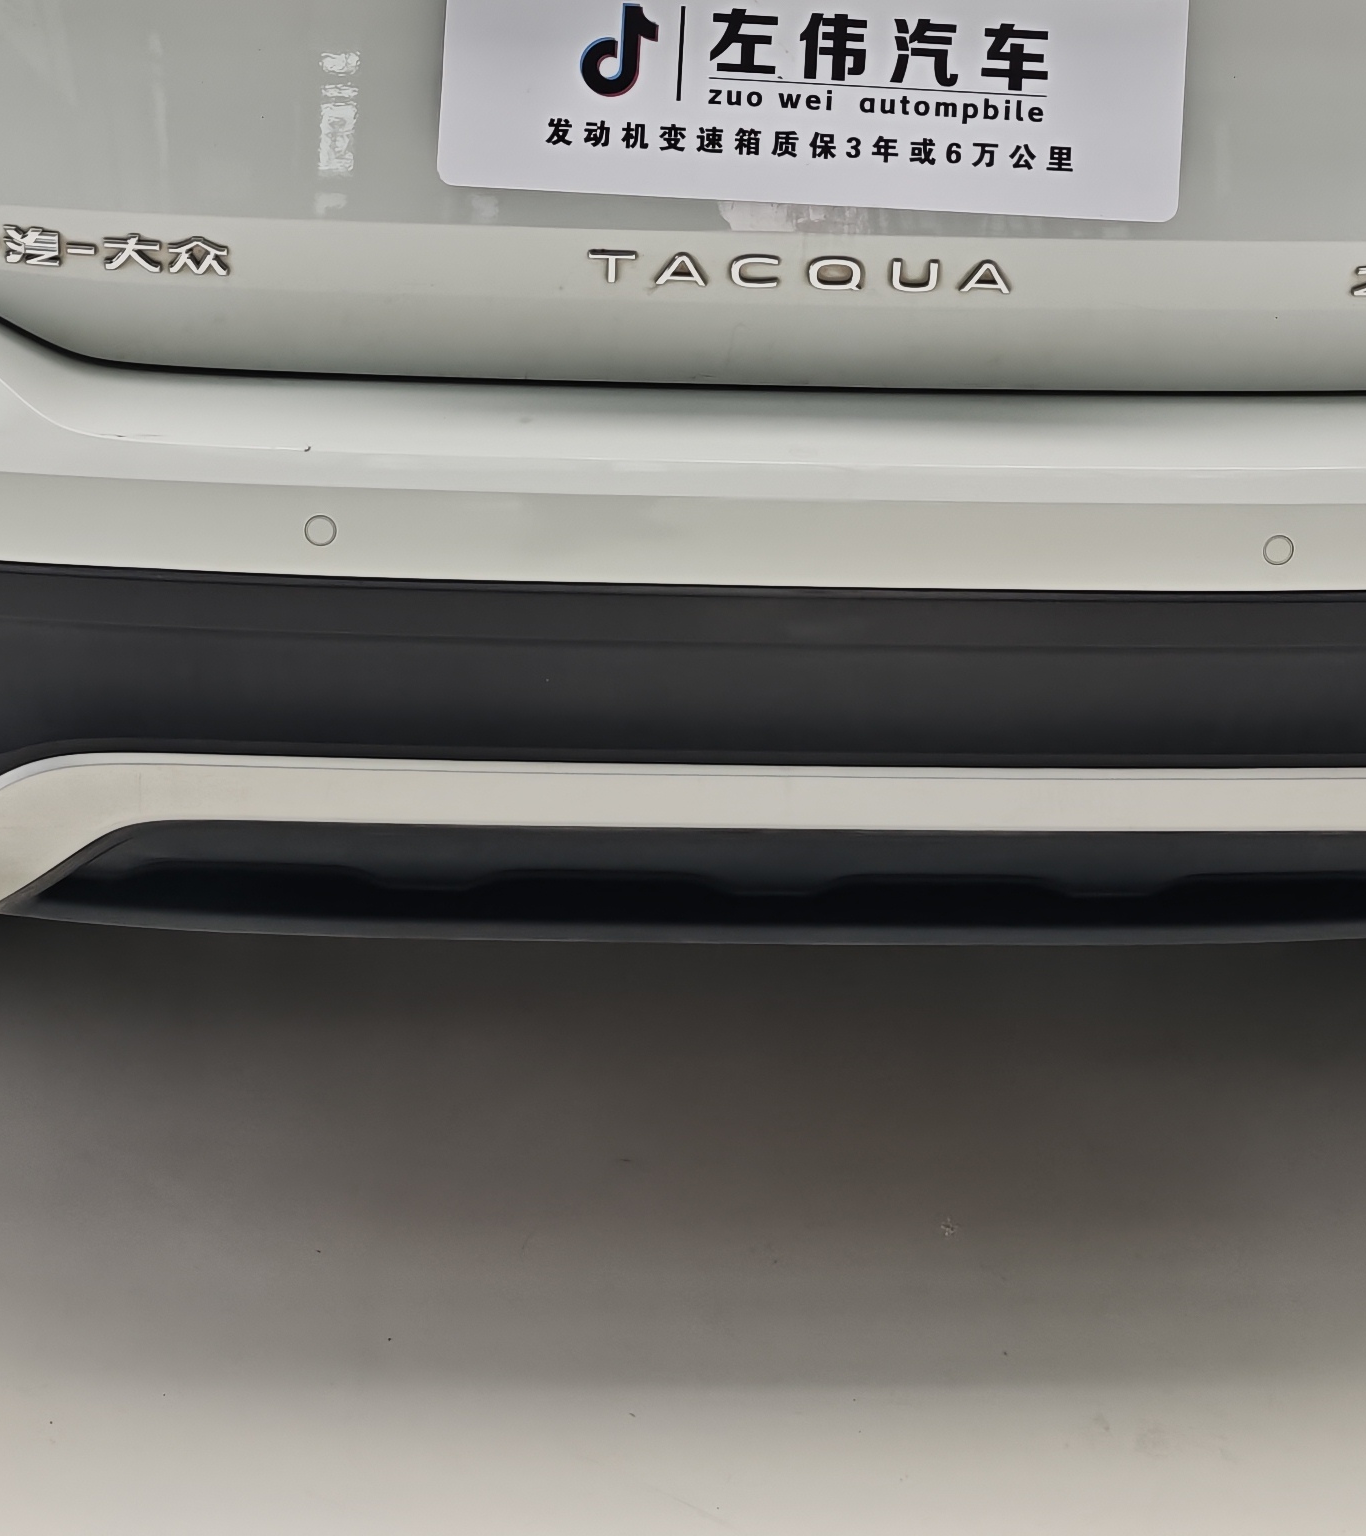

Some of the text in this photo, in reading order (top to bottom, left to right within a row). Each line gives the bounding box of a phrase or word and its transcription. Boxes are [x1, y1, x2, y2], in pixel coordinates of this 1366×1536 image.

[708, 8, 1050, 91] 左伟汽车
[708, 89, 1045, 124] zuo wei autompbile
[545, 117, 1075, 173] 发动机变速箱质保3年或6万公里
[587, 248, 1012, 295] TACQUA
